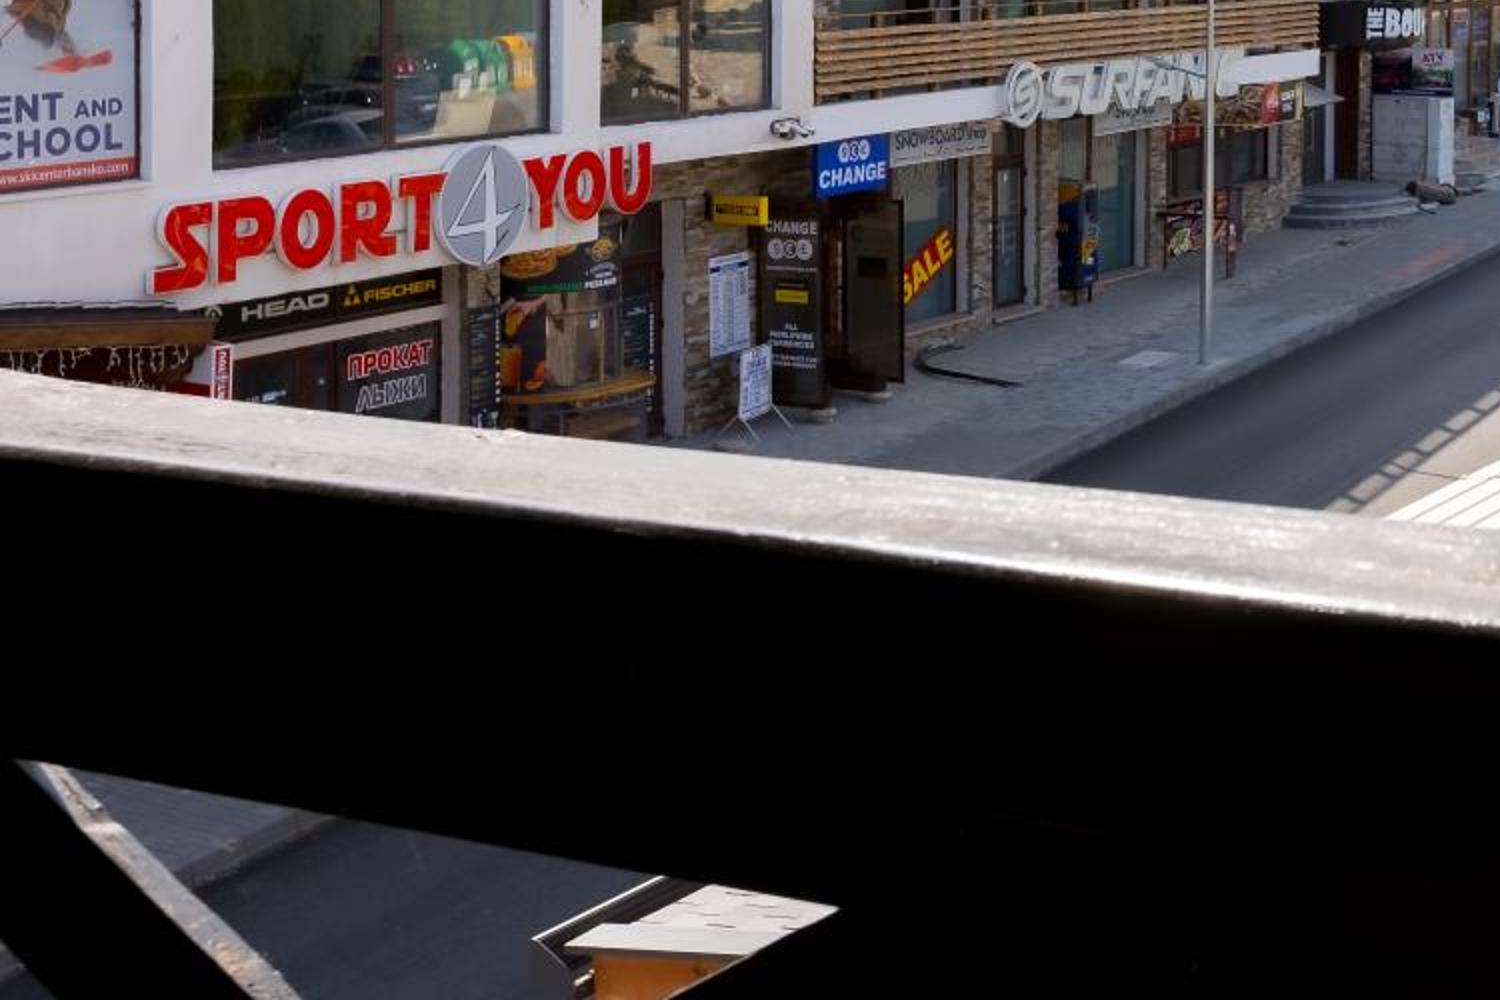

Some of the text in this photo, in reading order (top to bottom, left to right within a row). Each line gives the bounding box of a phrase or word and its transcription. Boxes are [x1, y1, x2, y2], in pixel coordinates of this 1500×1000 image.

[1366, 7, 1384, 40] THE
[74, 97, 122, 119] AND
[818, 161, 886, 189] CHANGE
[150, 172, 448, 296] SPORT
[522, 141, 653, 230] YOU
[766, 219, 818, 236] CHANGE
[241, 279, 437, 322] HEAD FISCHER
[347, 339, 432, 380] ПРОКАТ
[356, 374, 427, 413] ЛЫЖИ
